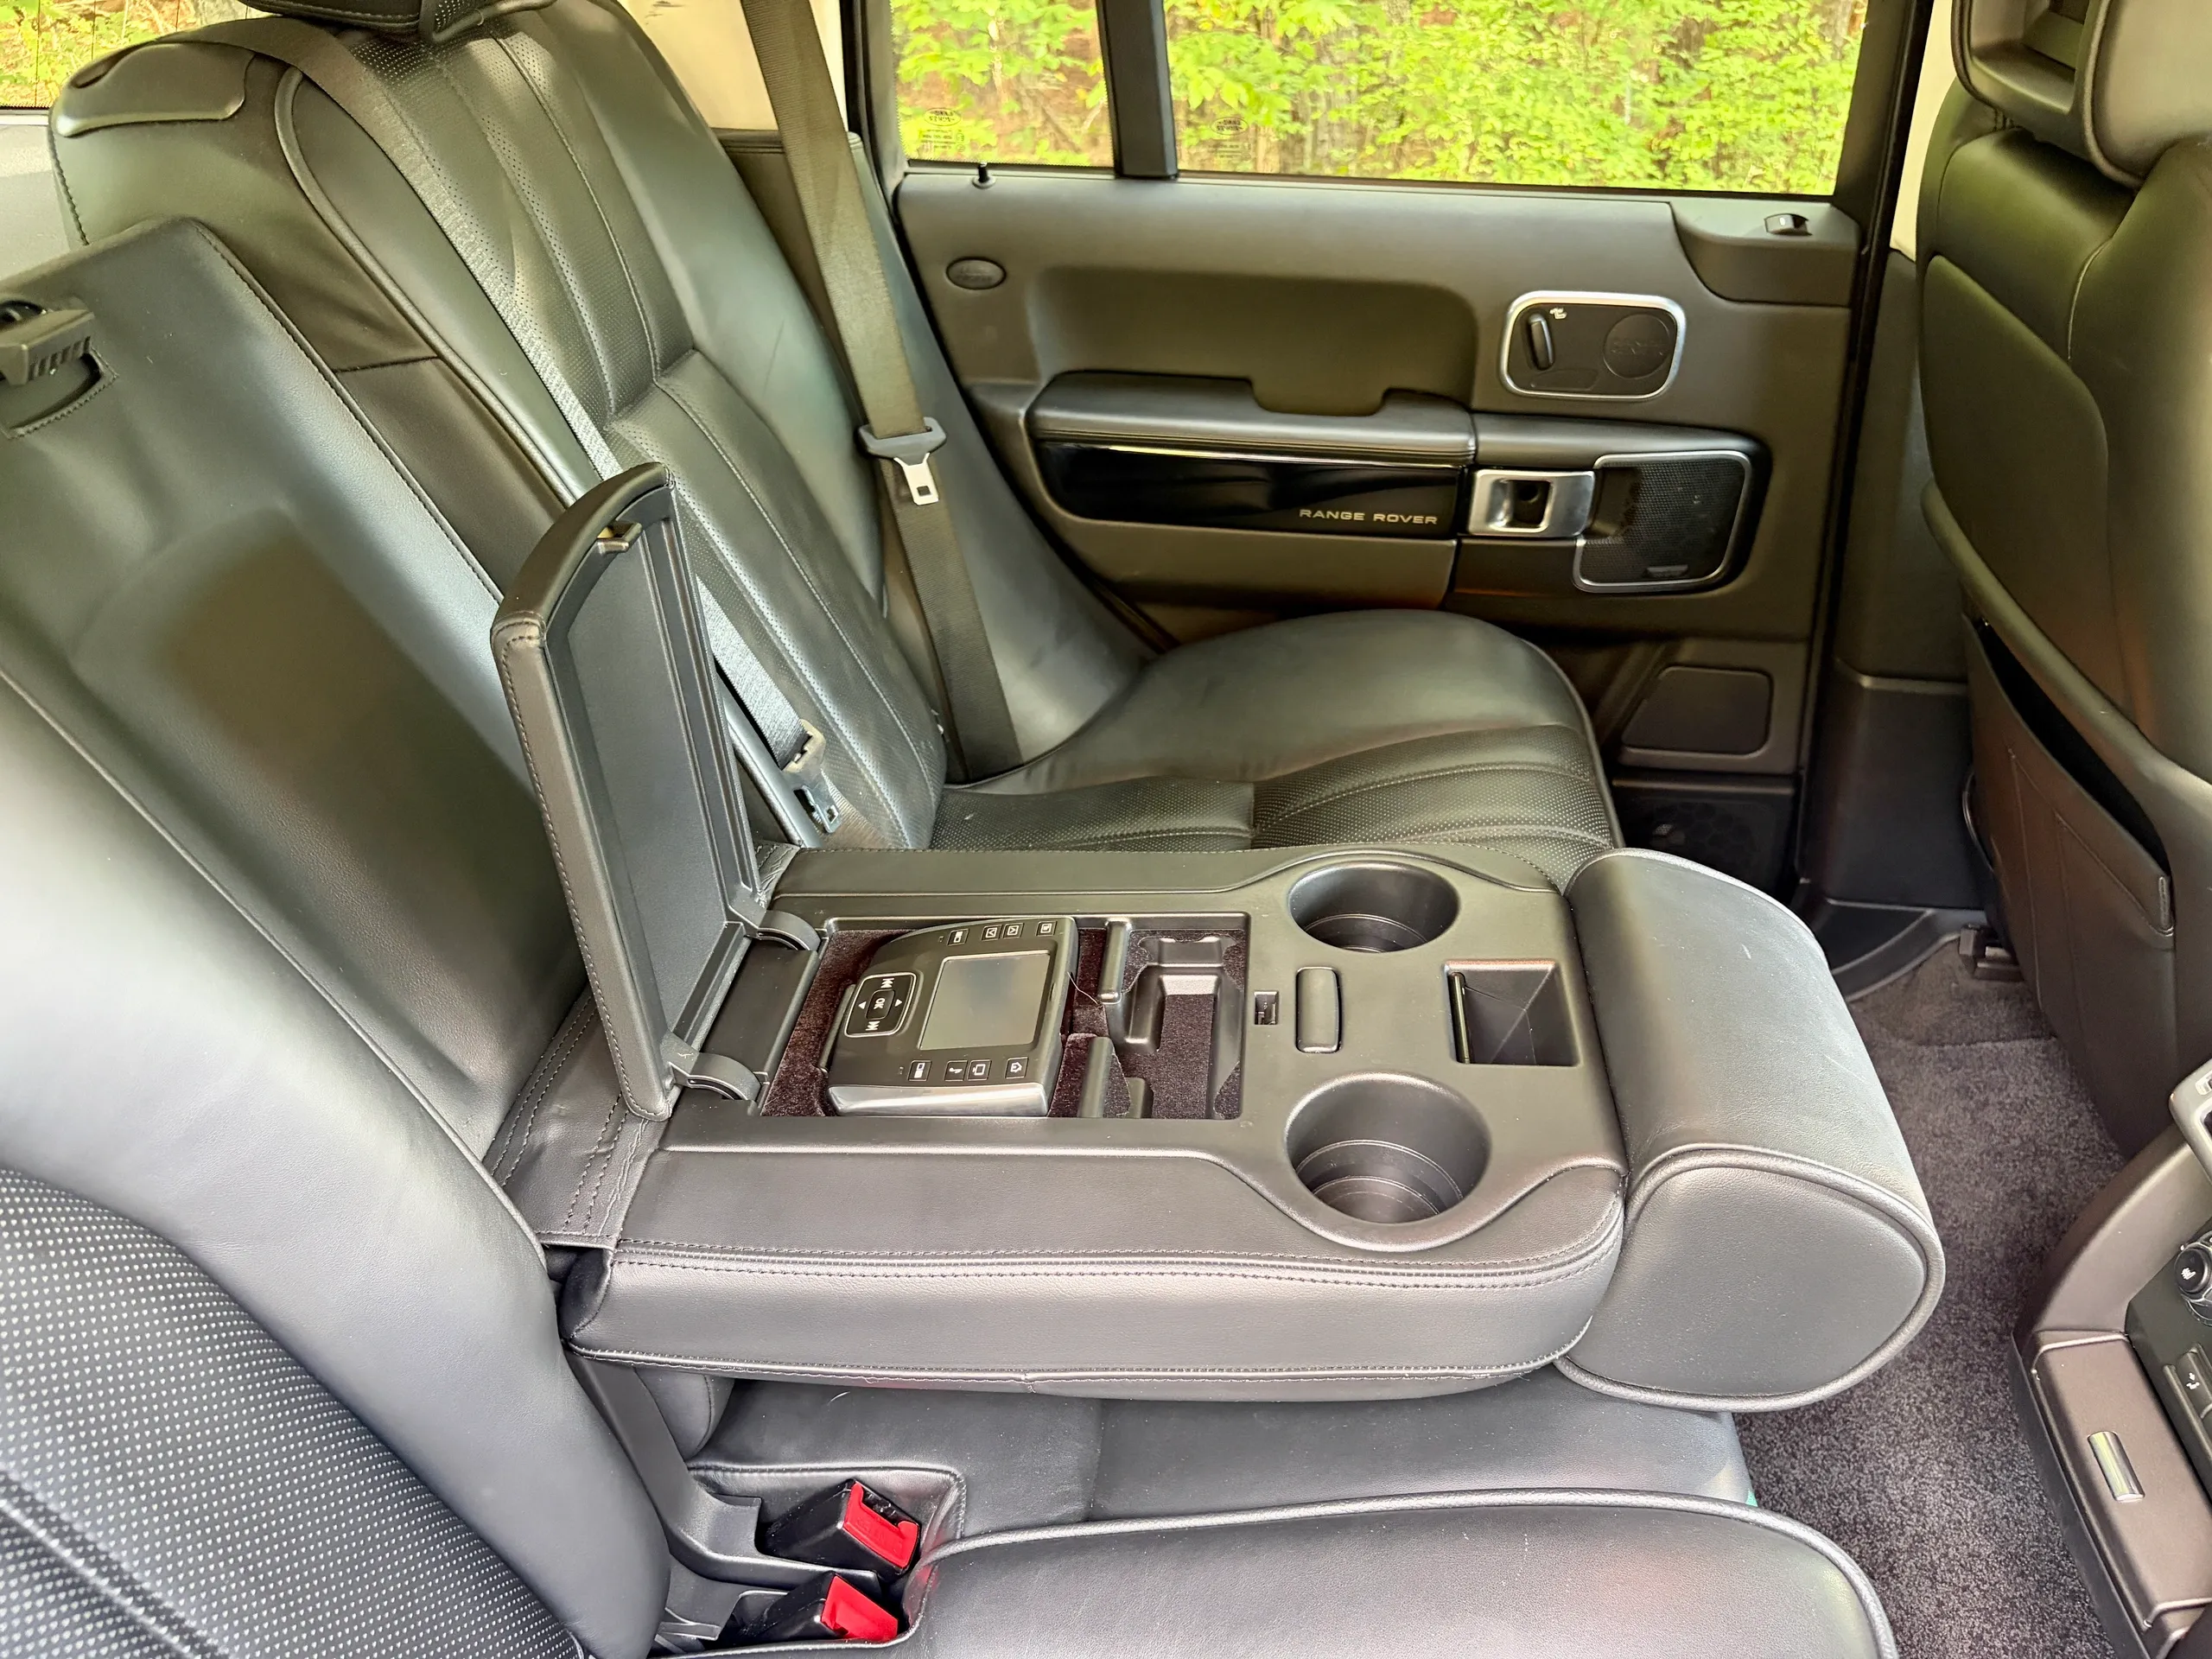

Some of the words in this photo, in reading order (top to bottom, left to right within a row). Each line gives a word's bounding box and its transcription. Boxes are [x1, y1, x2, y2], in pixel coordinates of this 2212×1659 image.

[1299, 509, 1365, 520] RANGE
[1373, 513, 1438, 524] ROVER
[873, 997, 886, 1010] OK
